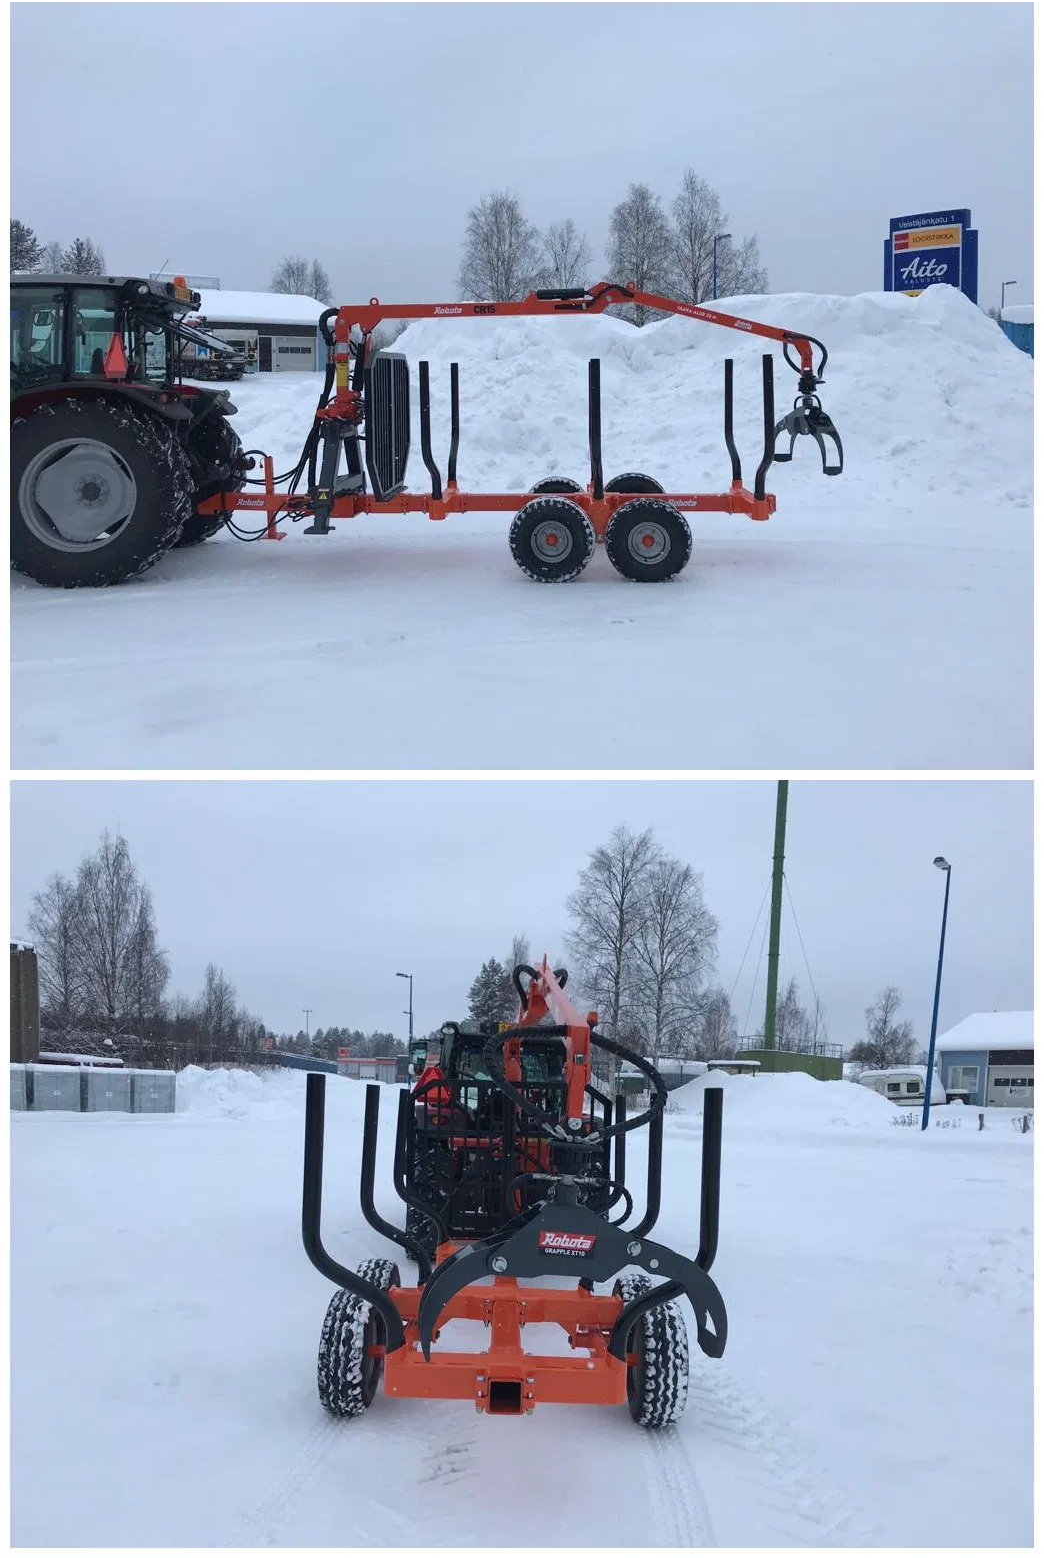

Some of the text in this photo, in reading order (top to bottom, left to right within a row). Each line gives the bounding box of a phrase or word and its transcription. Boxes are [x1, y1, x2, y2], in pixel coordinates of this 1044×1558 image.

[900, 256, 948, 279] Aito
[473, 305, 495, 314] CR15
[541, 1232, 592, 1249] Robota
[544, 1247, 571, 1255] GRAPPLE
